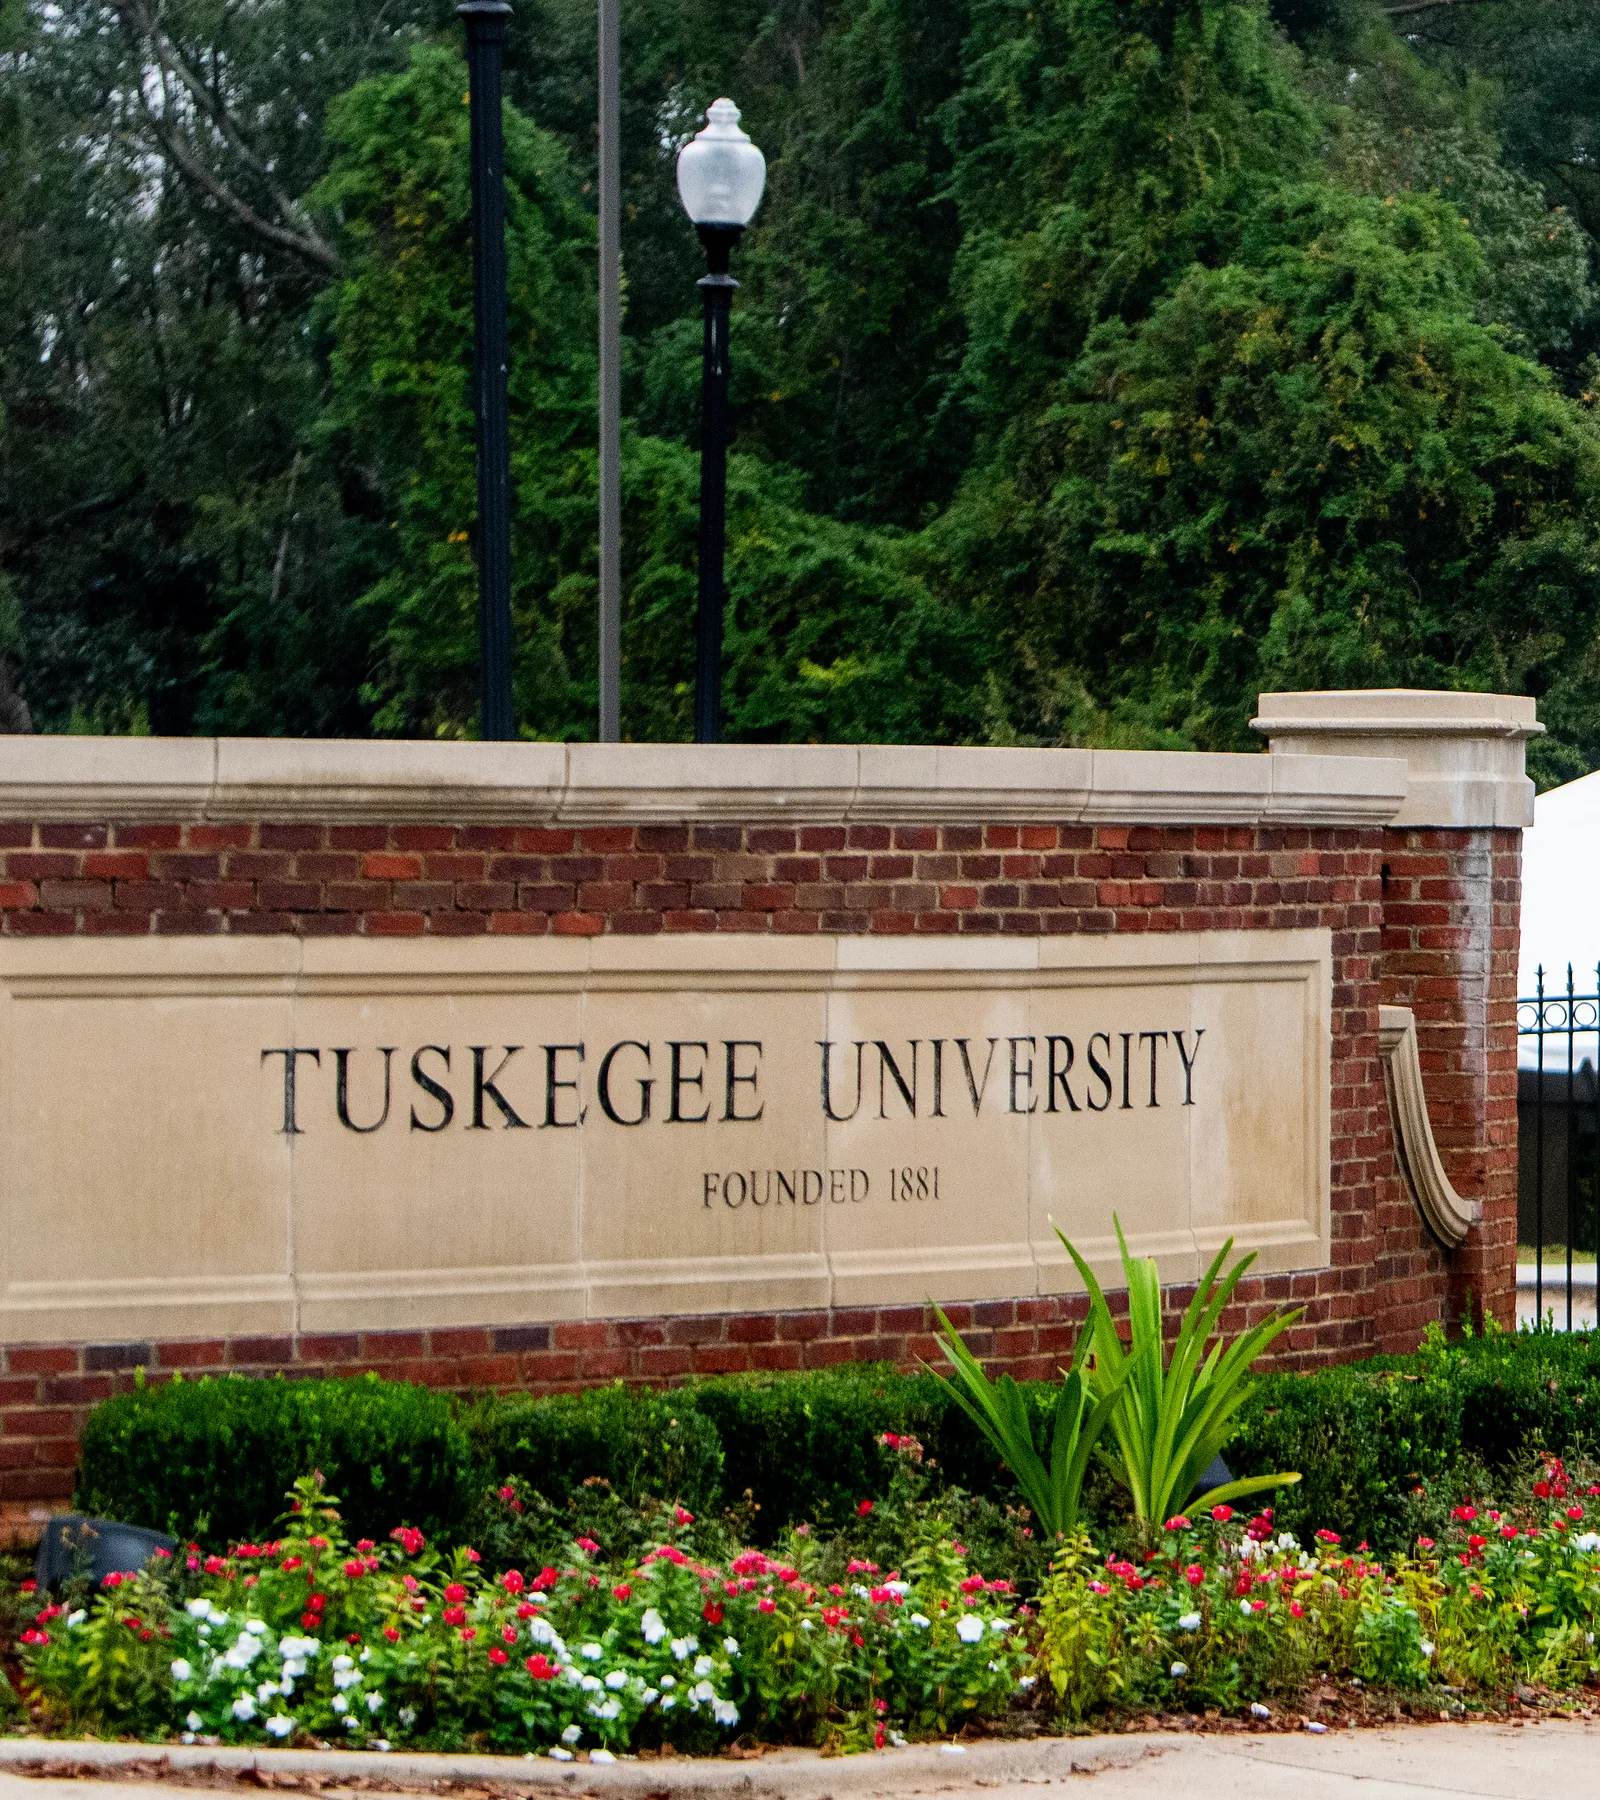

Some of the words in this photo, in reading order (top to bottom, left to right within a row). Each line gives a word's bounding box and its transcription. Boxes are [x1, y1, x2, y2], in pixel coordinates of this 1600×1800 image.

[260, 1040, 766, 1134] TUSKEGEE
[815, 1029, 1206, 1121] UNIVERSITY
[703, 1168, 869, 1209] FOUNDED
[890, 1166, 940, 1202] 1881
